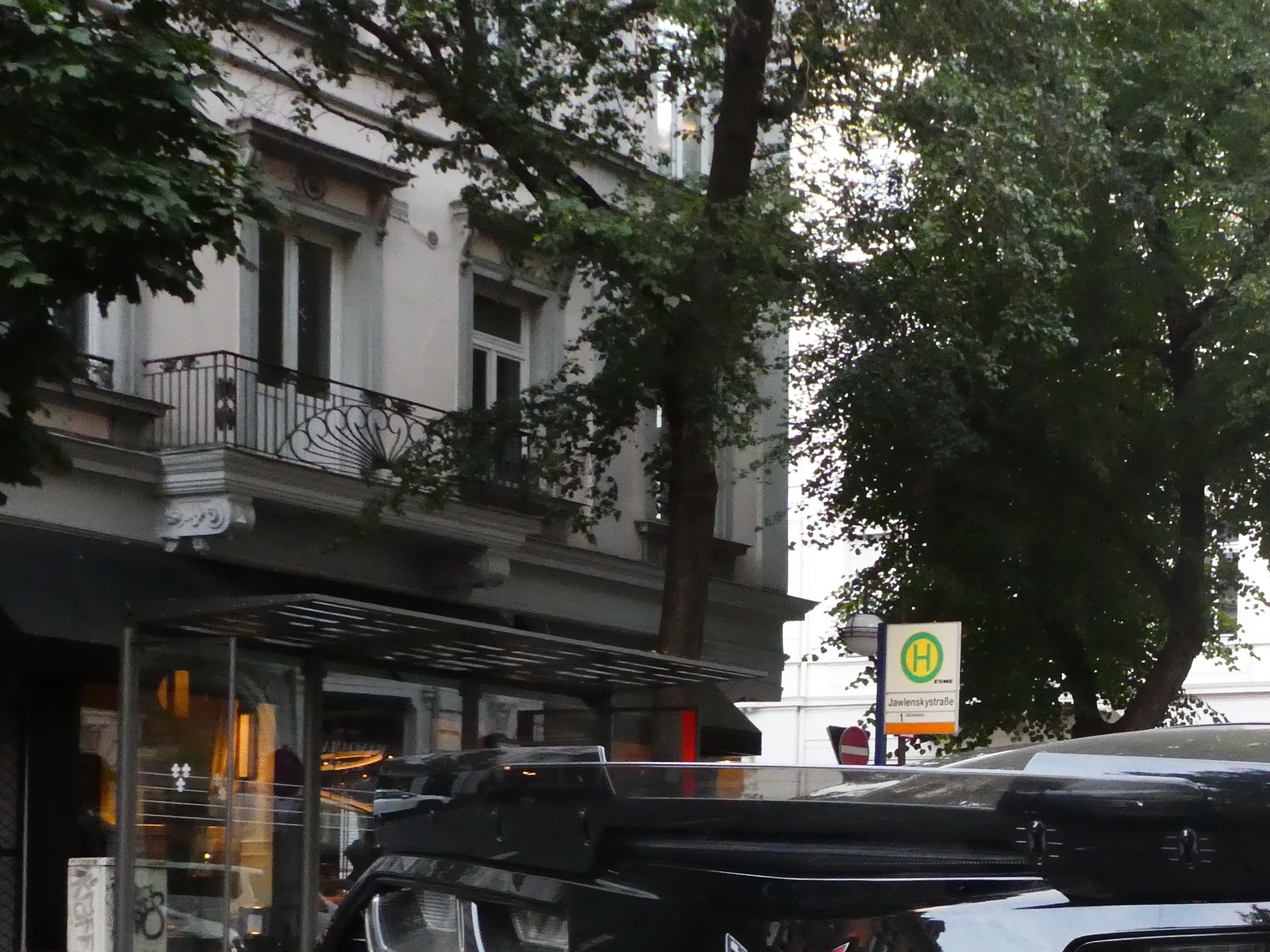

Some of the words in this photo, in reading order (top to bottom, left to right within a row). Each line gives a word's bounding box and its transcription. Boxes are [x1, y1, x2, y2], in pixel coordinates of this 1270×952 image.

[913, 643, 931, 672] H
[888, 697, 954, 709] Jawlenskystraße
[899, 713, 904, 722] 1
